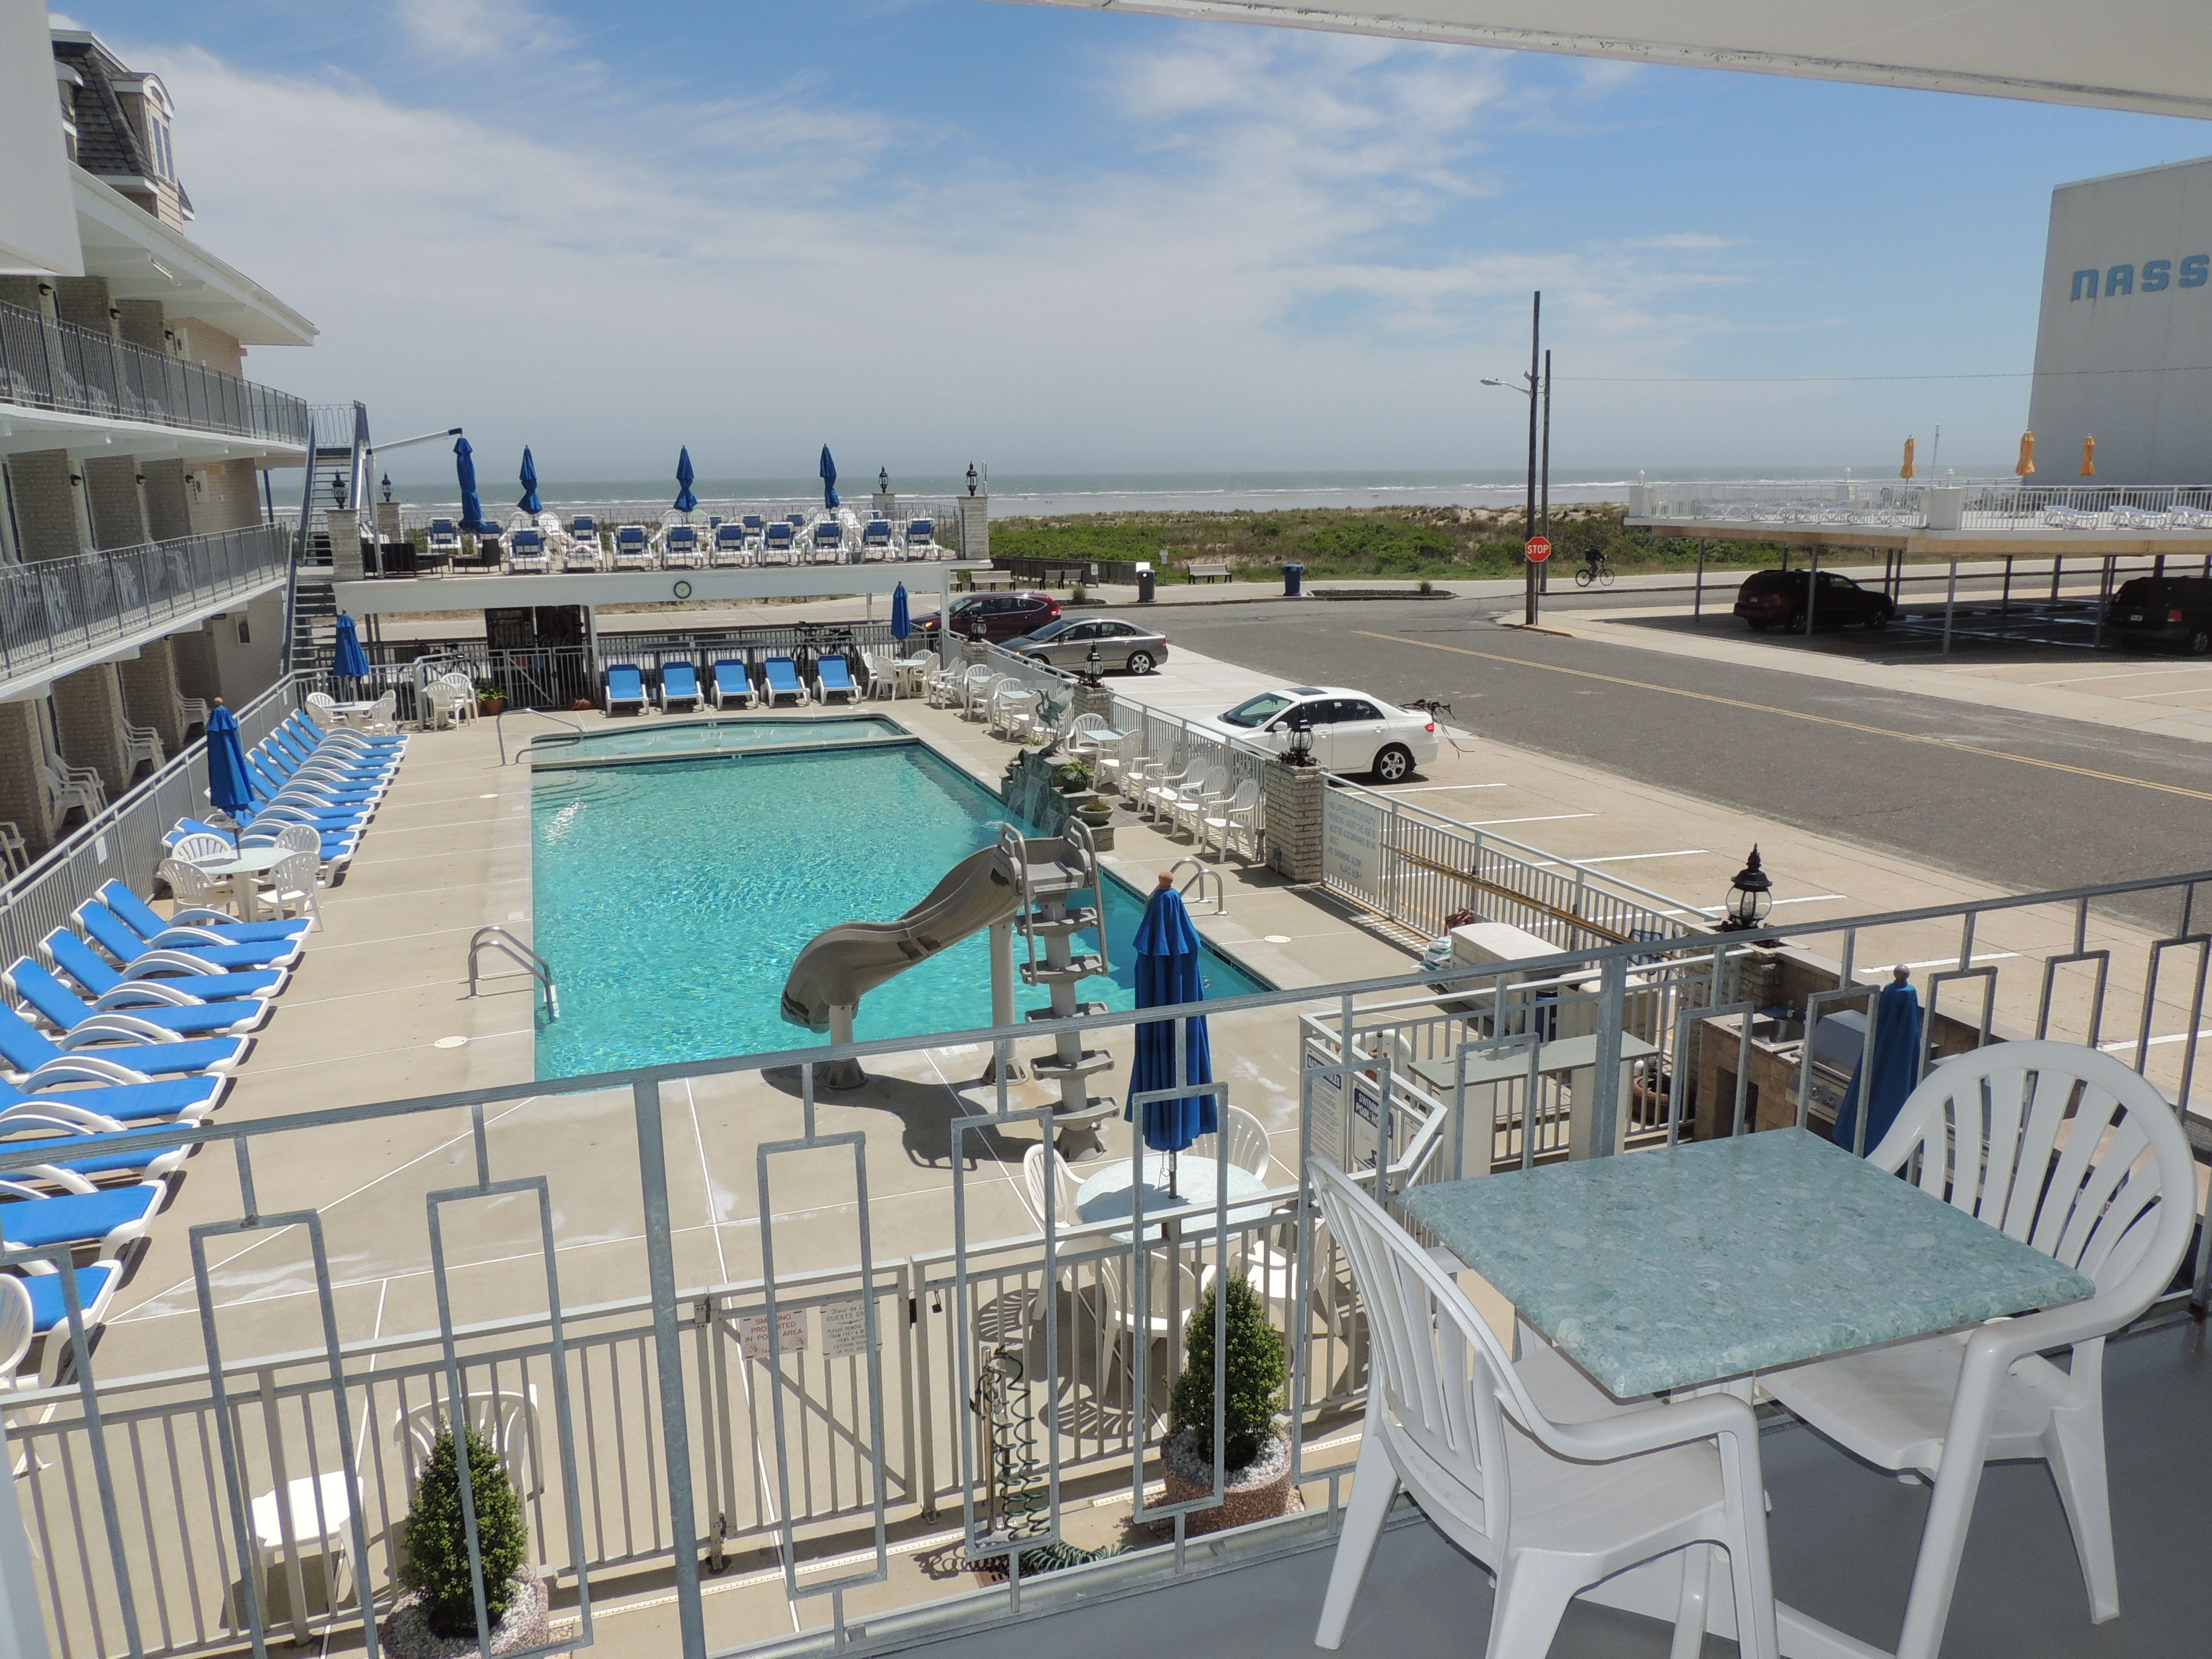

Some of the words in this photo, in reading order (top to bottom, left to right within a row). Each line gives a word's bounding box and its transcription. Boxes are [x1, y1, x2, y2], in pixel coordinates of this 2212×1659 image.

[2070, 254, 2210, 301] NASS
[1527, 544, 1549, 554] STOP
[1355, 1102, 1370, 1120] POOL
[827, 1312, 853, 1321] GUESTS
[782, 1328, 803, 1337] AREA
